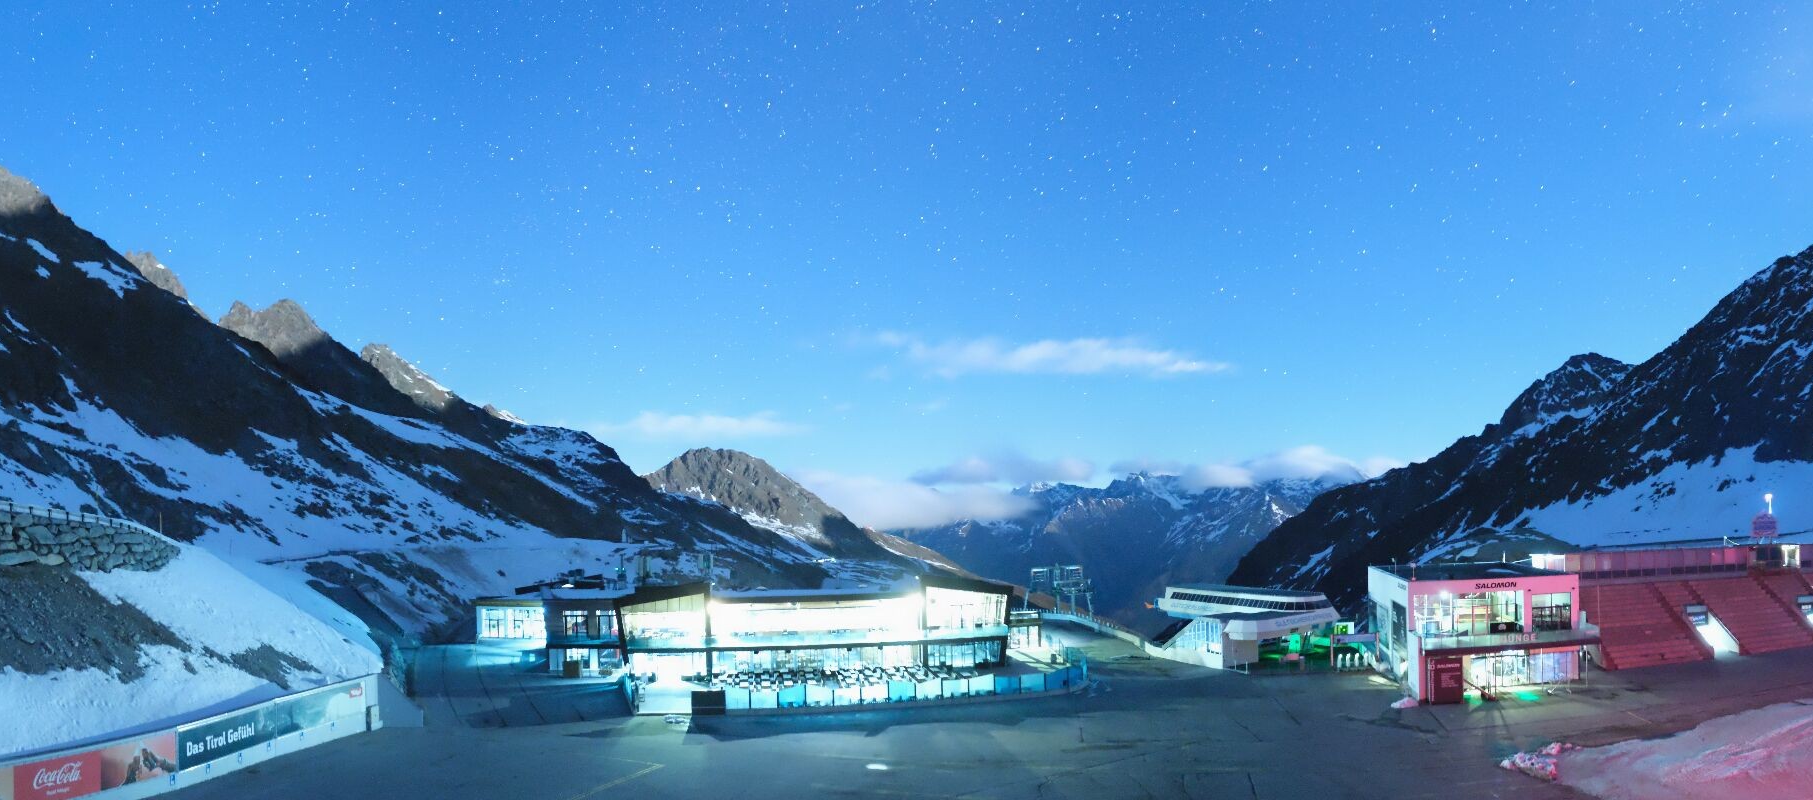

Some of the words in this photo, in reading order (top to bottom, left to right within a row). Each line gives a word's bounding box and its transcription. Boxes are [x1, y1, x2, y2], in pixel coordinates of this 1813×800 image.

[186, 741, 205, 757] Das
[205, 731, 226, 751] Tirol
[228, 721, 255, 744] Gefühl
